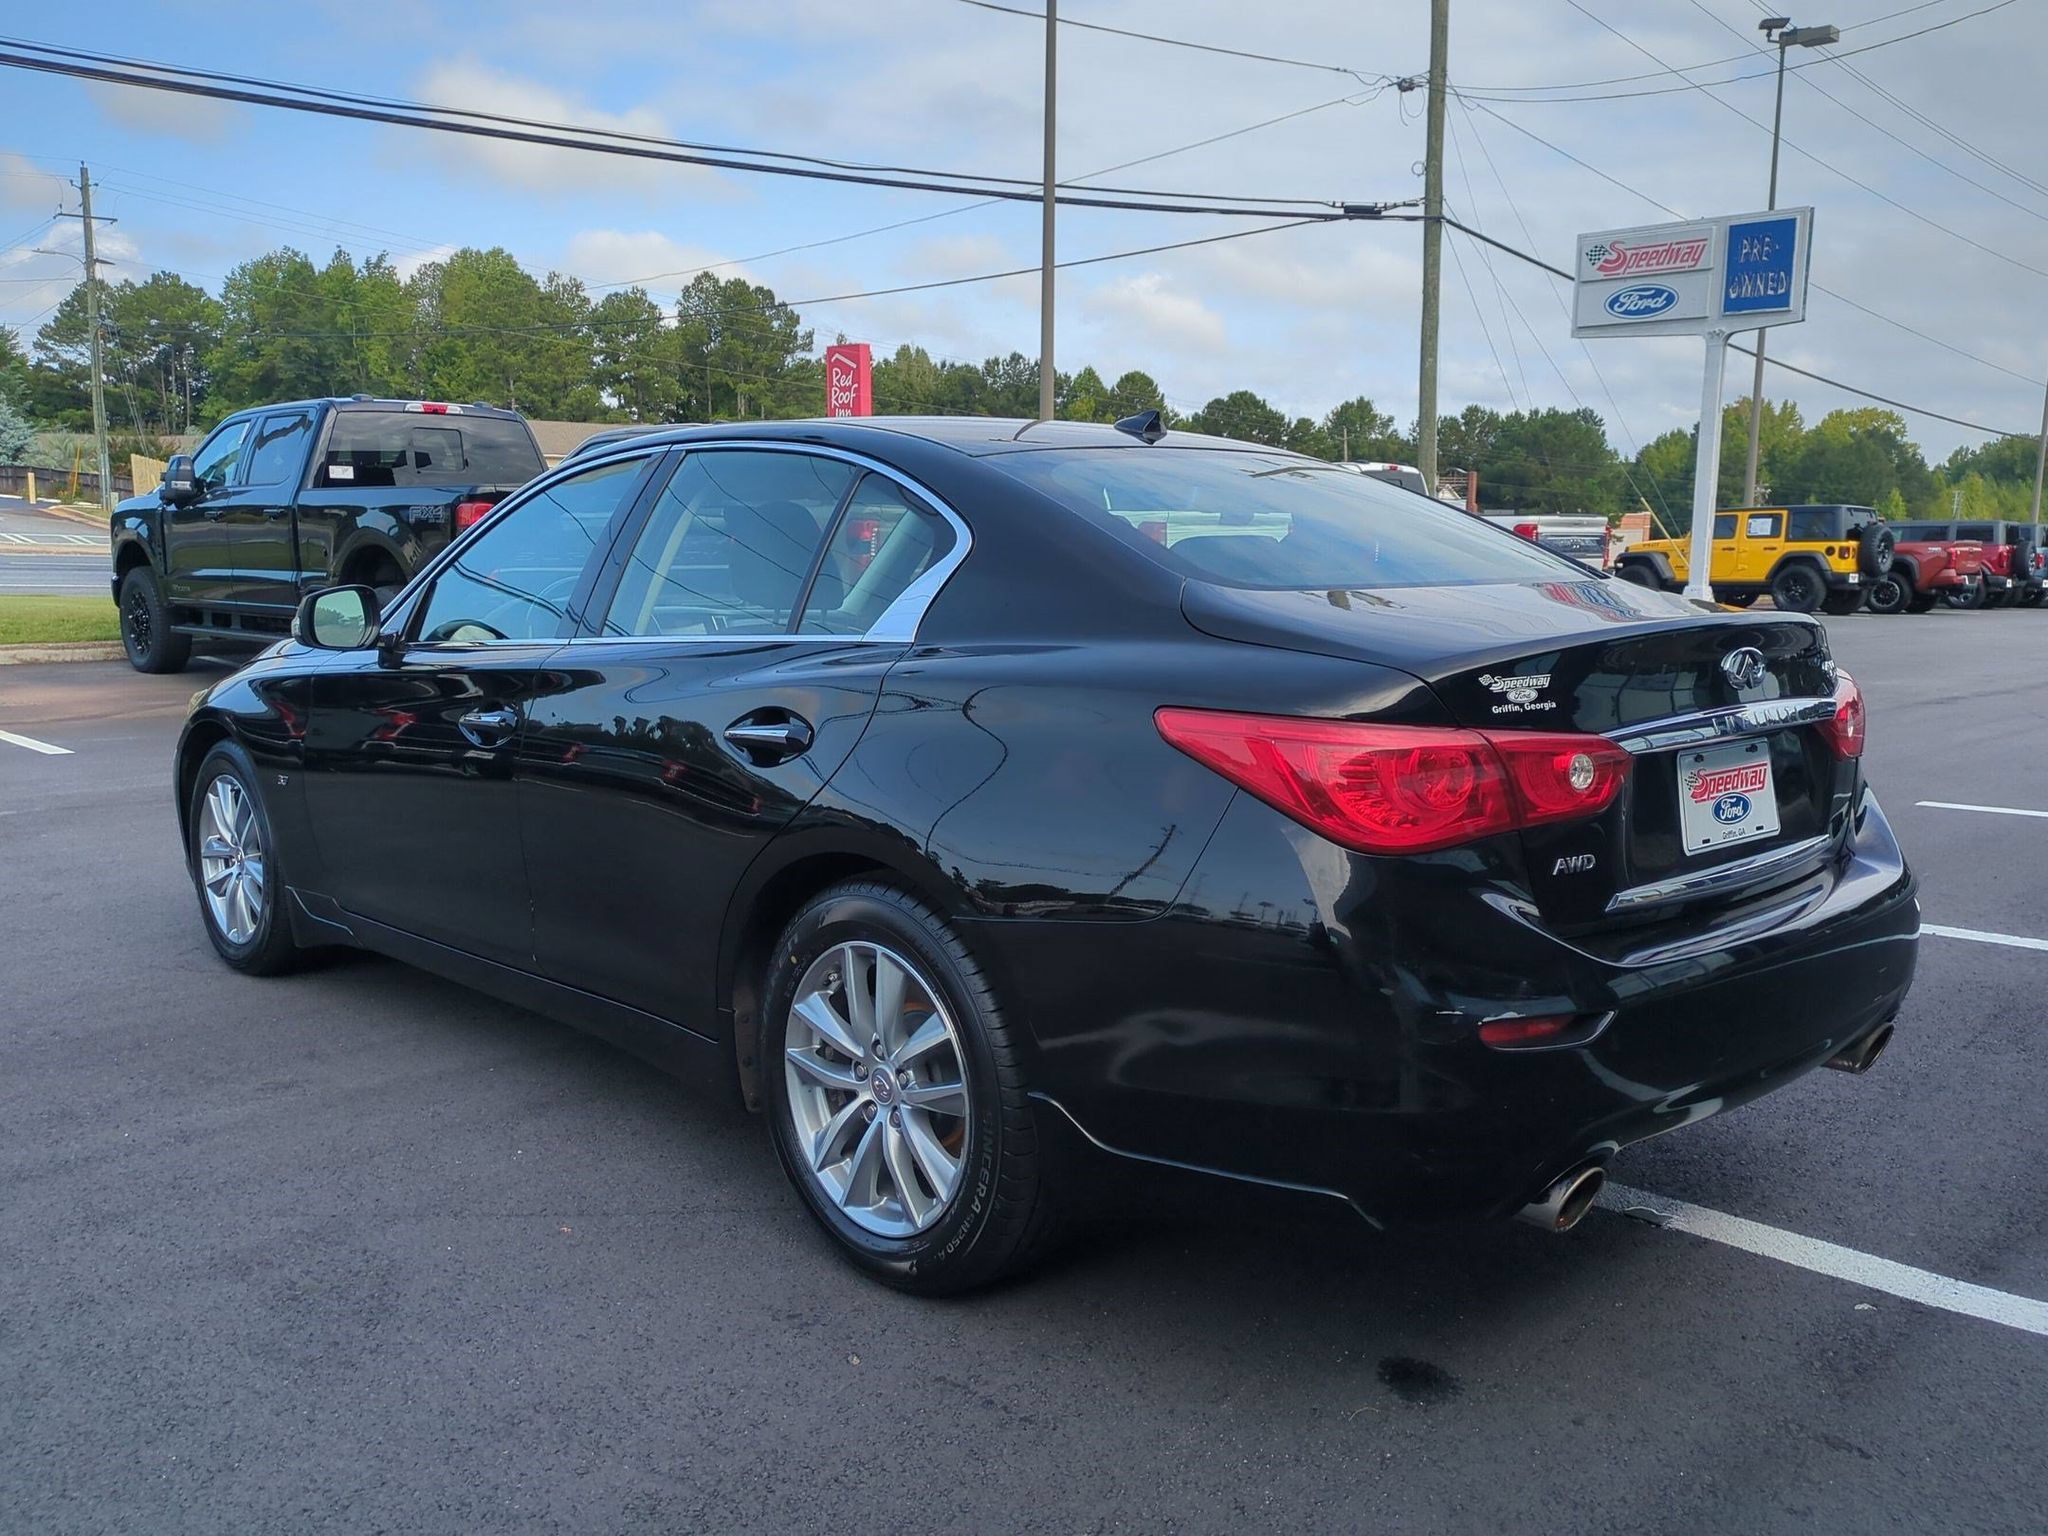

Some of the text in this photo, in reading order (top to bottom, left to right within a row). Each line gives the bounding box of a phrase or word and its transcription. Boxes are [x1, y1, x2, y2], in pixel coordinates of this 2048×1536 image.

[1596, 239, 1707, 276] Speedway
[1729, 272, 1789, 299] OWNED
[1615, 290, 1666, 312] Ford
[832, 367, 854, 388] Red
[831, 384, 858, 409] Roof
[409, 506, 445, 525] FX4
[1490, 674, 1551, 693] Speedway
[1513, 690, 1533, 700] Ford
[1492, 700, 1556, 714] Griffin, Georgia
[1690, 763, 1768, 803] Speedway
[1719, 798, 1744, 819] Ford
[1552, 853, 1597, 876] AWD
